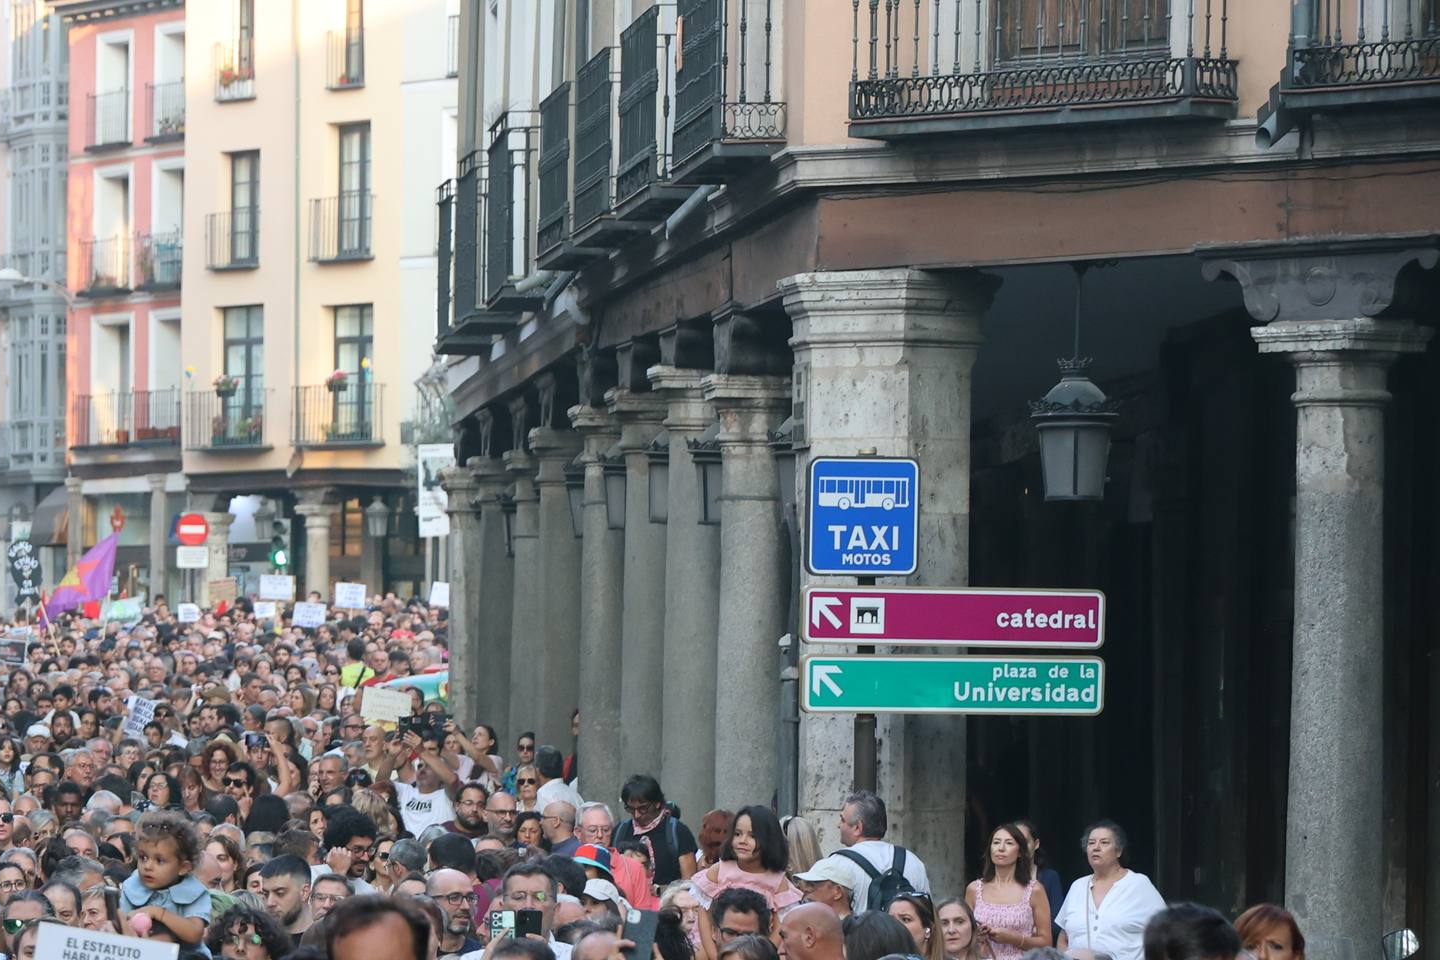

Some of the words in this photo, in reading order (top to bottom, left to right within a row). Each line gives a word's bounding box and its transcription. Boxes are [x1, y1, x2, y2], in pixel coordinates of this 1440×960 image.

[828, 525, 899, 550] TAXI
[842, 553, 891, 566] MOTOS
[996, 608, 1096, 629] catedral
[992, 664, 1037, 682] plaza
[1048, 664, 1069, 678] de
[1080, 664, 1095, 679] la
[953, 681, 1095, 703] Universidad
[67, 937, 80, 950] EL
[83, 940, 141, 959] ESTATUTO
